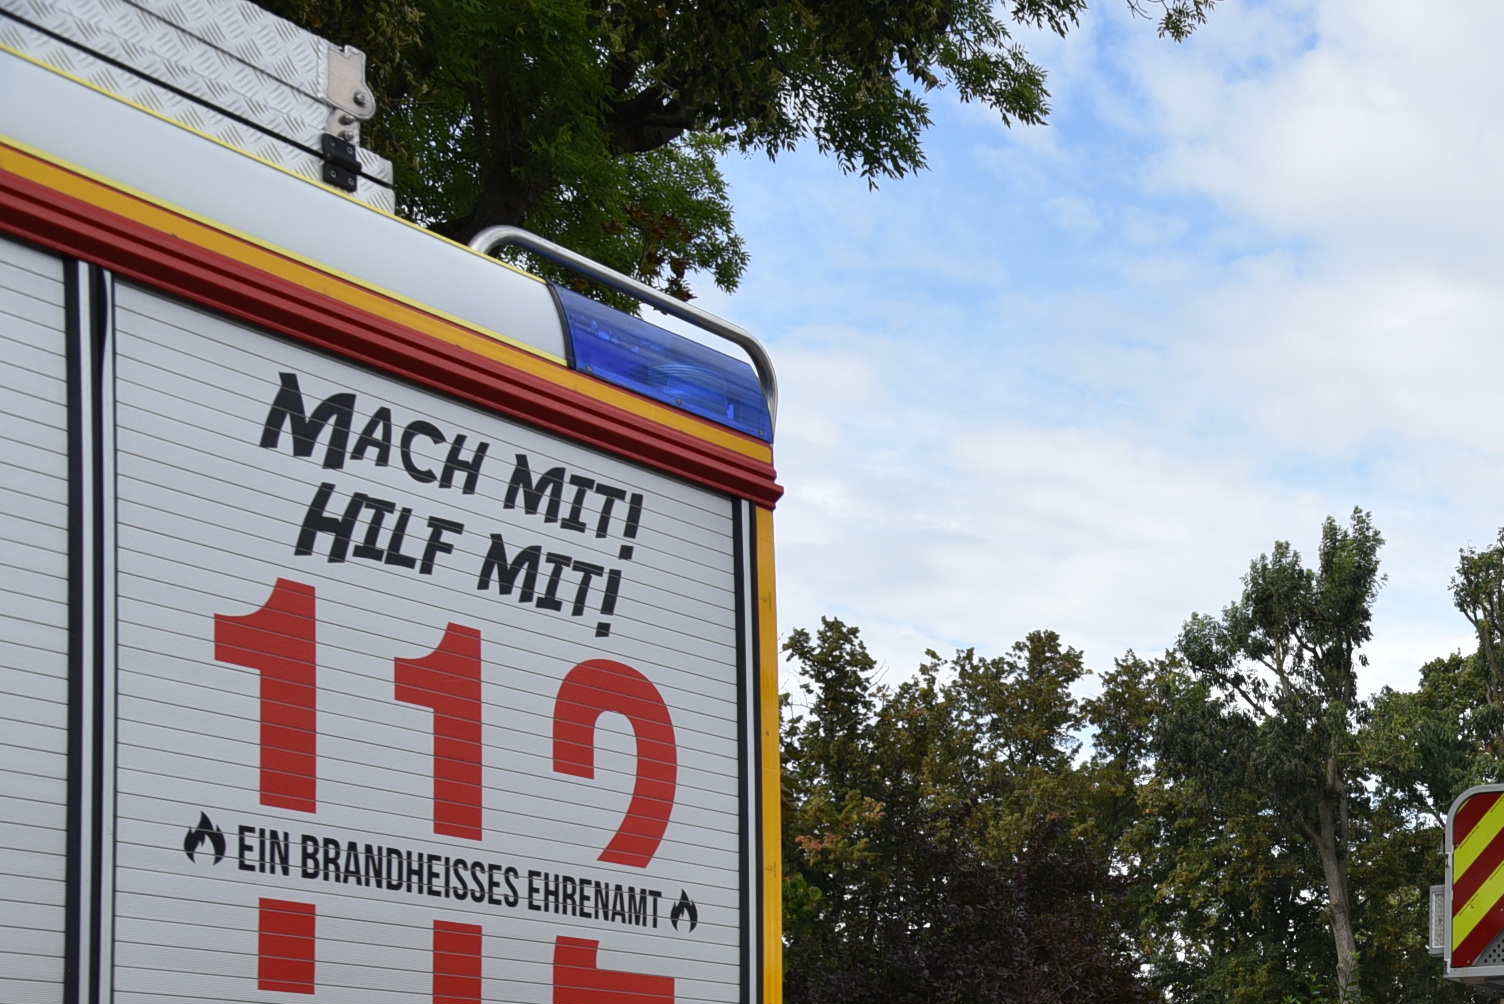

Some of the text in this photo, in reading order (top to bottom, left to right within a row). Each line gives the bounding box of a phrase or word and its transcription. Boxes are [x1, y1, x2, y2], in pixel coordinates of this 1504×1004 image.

[259, 372, 645, 561] MACH MIT!
[293, 482, 623, 638] HILF MIT!
[238, 825, 662, 930] EIN BRANDHEISSES EHRENAMT
